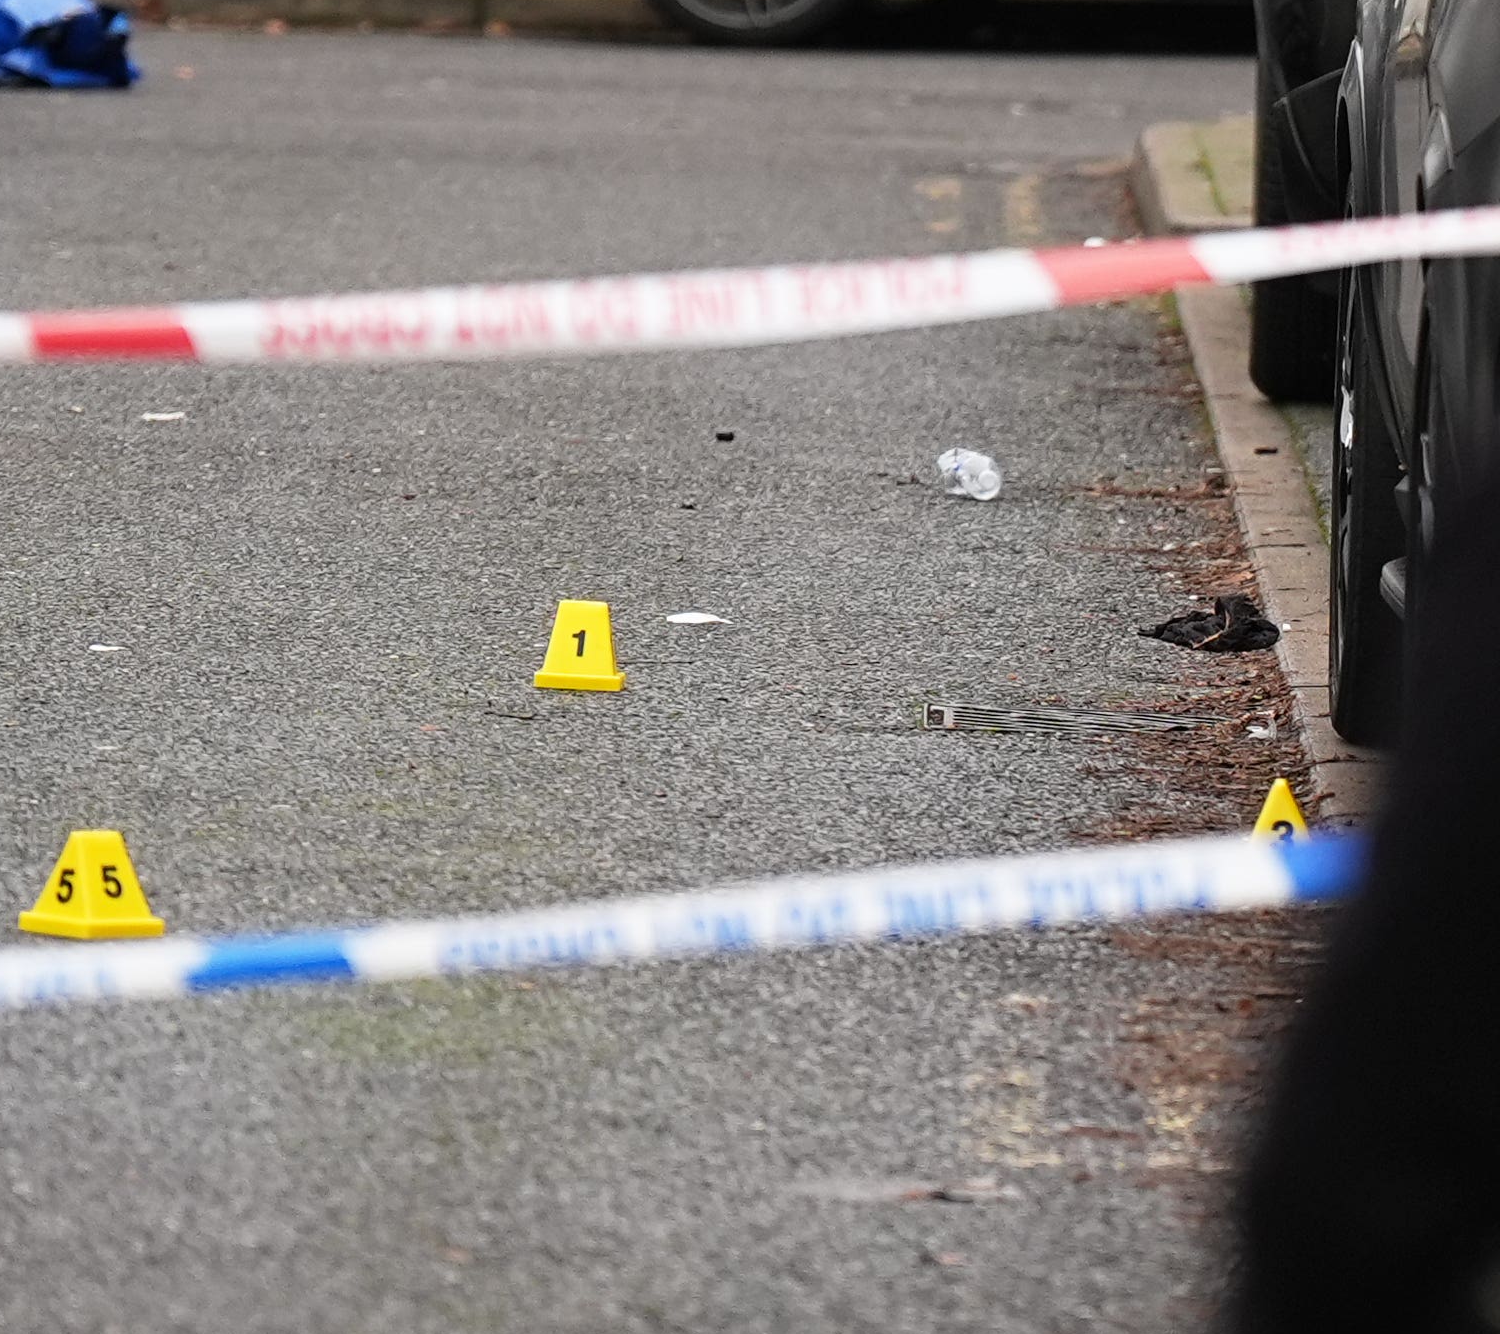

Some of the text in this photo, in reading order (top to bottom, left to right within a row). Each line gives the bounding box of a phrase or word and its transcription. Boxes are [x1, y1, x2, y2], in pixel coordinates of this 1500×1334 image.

[571, 629, 587, 658] 1
[56, 868, 76, 904] 5
[100, 864, 123, 899] 5
